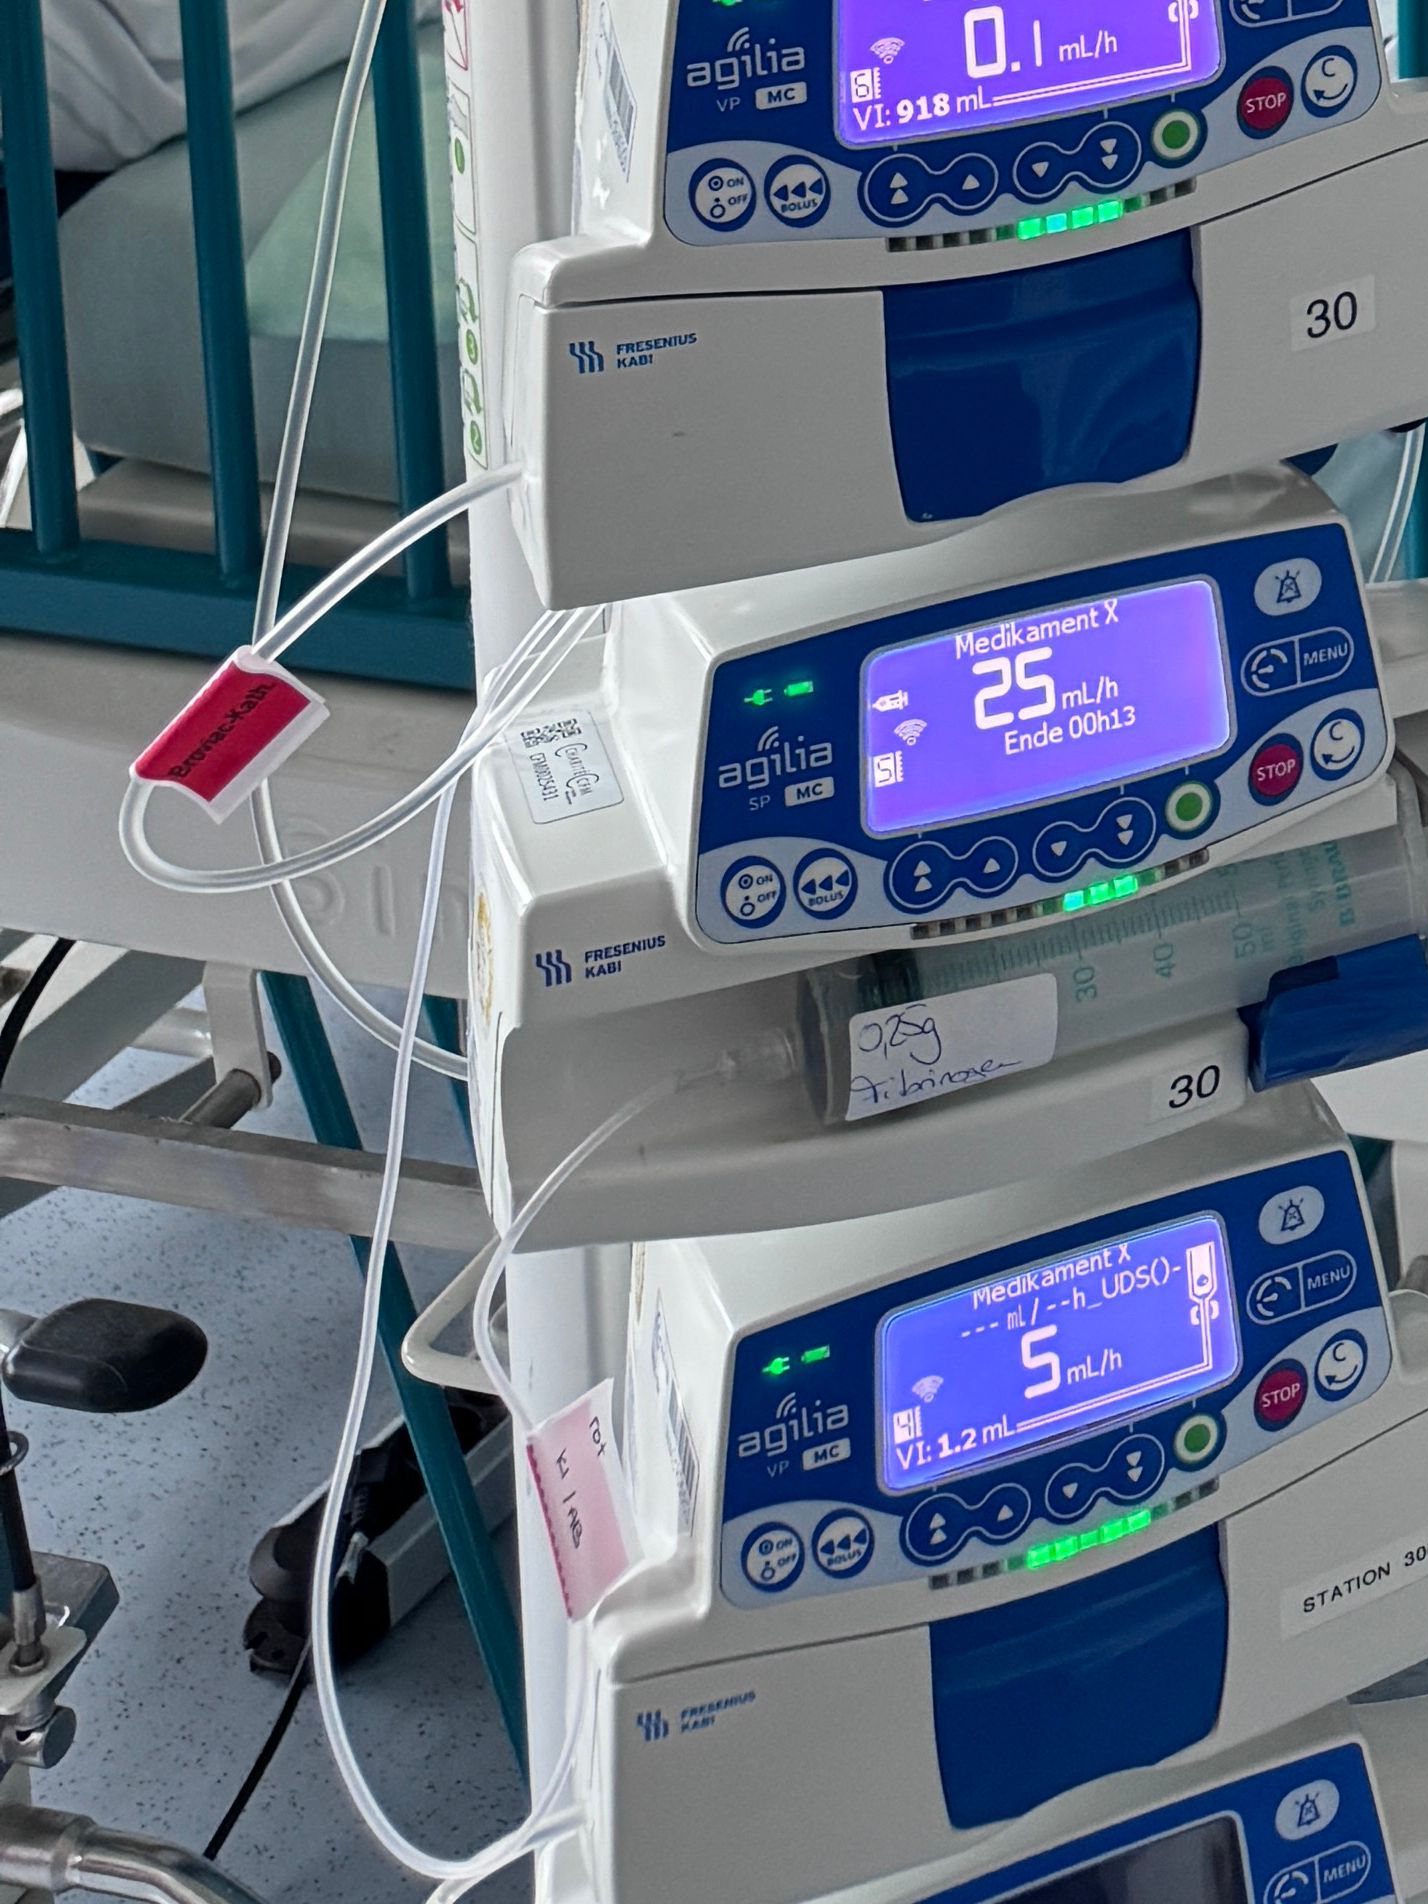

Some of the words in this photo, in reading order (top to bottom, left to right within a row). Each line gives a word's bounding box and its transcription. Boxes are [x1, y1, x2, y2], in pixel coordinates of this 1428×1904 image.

[963, 5, 1044, 79] 0.1
[1058, 29, 1119, 63] mL/h
[686, 37, 806, 91] agilia
[1321, 57, 1336, 77] C
[716, 96, 741, 113] VP
[767, 88, 797, 104] MC
[852, 103, 892, 132] VI:
[896, 93, 951, 124] 918
[955, 85, 993, 113] mL
[1245, 92, 1287, 114] STOP
[726, 177, 745, 188] ON
[728, 193, 748, 206] OFF
[780, 198, 818, 214] BOLUS
[1306, 291, 1358, 339] 30
[616, 332, 698, 355] FRESENIUS
[616, 354, 654, 369] KABI
[955, 607, 1100, 660] Medikament
[1104, 598, 1119, 624] X
[1303, 642, 1348, 667] MENU
[971, 646, 1057, 731] 25
[1061, 676, 1119, 710] mL/h
[1004, 721, 1063, 755] Ende
[1069, 705, 1136, 739] 00h13
[1329, 720, 1344, 741] C
[718, 735, 833, 791] agilia
[1256, 758, 1296, 782] STOP
[749, 794, 771, 811] SP
[796, 782, 824, 800] MC
[756, 874, 774, 886] ON
[757, 890, 777, 904] OFF
[808, 891, 845, 907] BOLUS
[584, 935, 666, 964] FRESENIUS
[1231, 922, 1257, 961] 50
[585, 960, 622, 979] KABI
[1152, 943, 1176, 979] 40
[1072, 965, 1098, 1003] 30
[1168, 1064, 1221, 1110] 30
[972, 1249, 1112, 1310] Medikament
[1118, 1243, 1131, 1264] X
[1306, 1264, 1350, 1291] MENU
[1020, 1324, 1061, 1399] 5
[1067, 1348, 1122, 1385] mL/h
[1332, 1342, 1346, 1362] C
[1261, 1382, 1301, 1408] STOP
[738, 1399, 849, 1458] agilia
[896, 1444, 932, 1471] VI:
[938, 1429, 976, 1459] 1.2
[982, 1414, 1016, 1444] mL
[766, 1460, 790, 1478] VP
[814, 1444, 840, 1463] MC
[776, 1538, 793, 1550] ON
[826, 1549, 862, 1567] BOLUS
[777, 1553, 798, 1567] OFF
[1302, 1561, 1391, 1613] STATION
[1323, 1853, 1366, 1883] MENU
